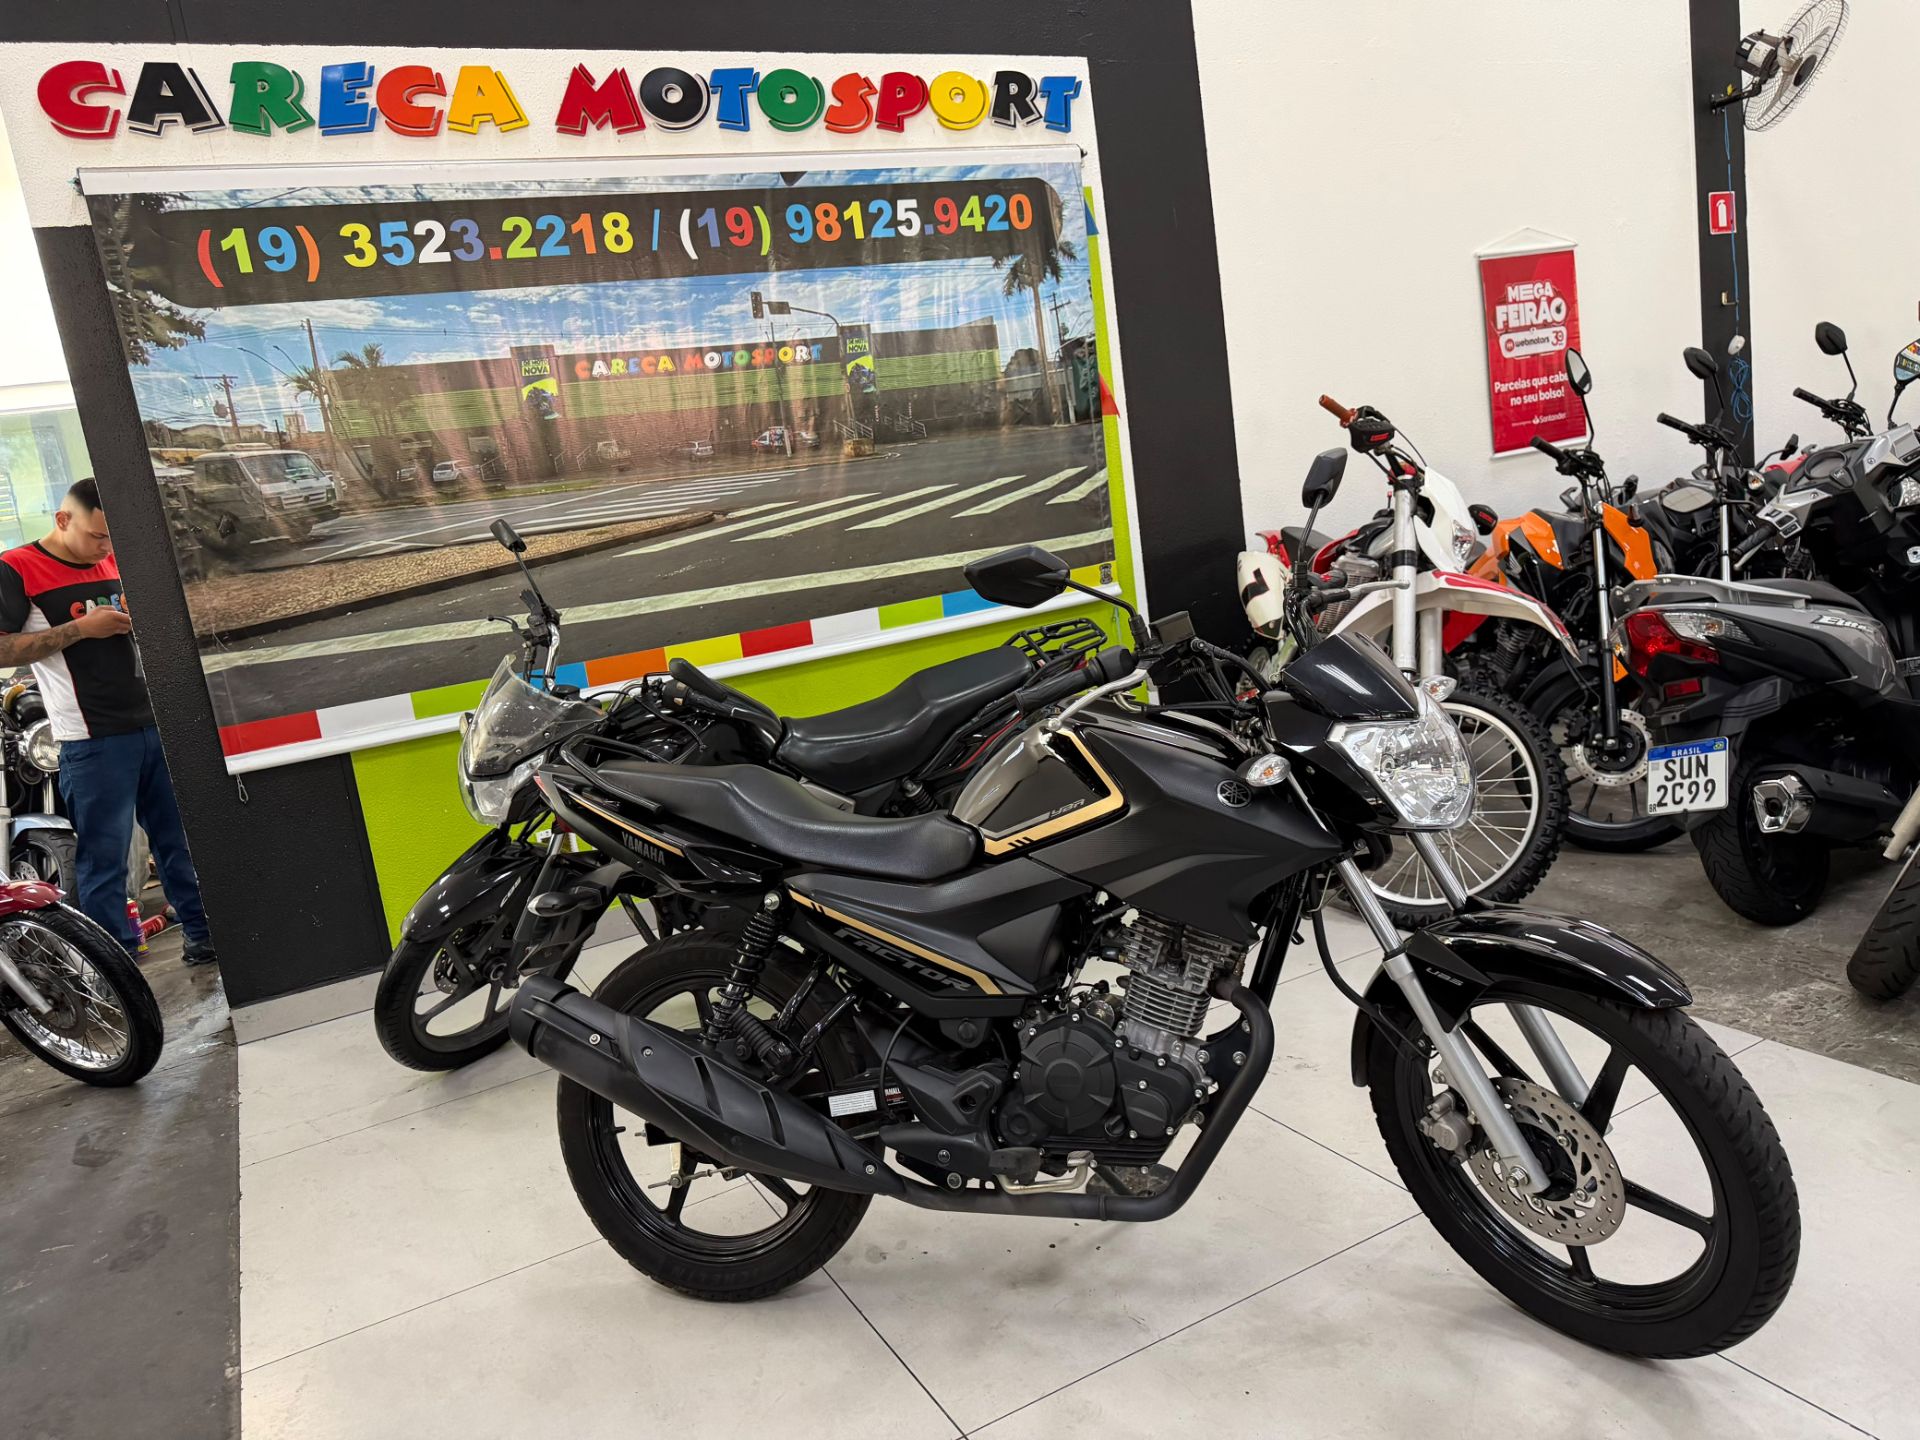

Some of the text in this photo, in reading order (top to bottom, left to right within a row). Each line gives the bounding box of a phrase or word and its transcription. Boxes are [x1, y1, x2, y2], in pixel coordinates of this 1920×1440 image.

[37, 60, 1082, 139] CARECA MOTOSPORT
[197, 225, 320, 288] (19)
[339, 211, 634, 268] 3523.2218
[680, 205, 771, 260] (19)
[788, 193, 1034, 245] 98125.9420
[1507, 281, 1554, 302] MEGA
[1495, 296, 1567, 330] FEIRÃO
[847, 345, 869, 353] NOVA
[523, 367, 549, 376] NOVA
[575, 344, 823, 380] CARECA MOTOSPORT
[1494, 378, 1531, 394] Parcelas
[1532, 375, 1548, 388] que
[1510, 386, 1565, 407] no seu bolso!
[1539, 412, 1567, 424] Santander
[1671, 746, 1702, 757] BRASIL
[1664, 754, 1709, 782] SUN
[1656, 778, 1716, 808] 2C99
[1649, 803, 1657, 813] BR
[621, 831, 666, 867] YAMAHA
[834, 927, 973, 992] FACTOR
